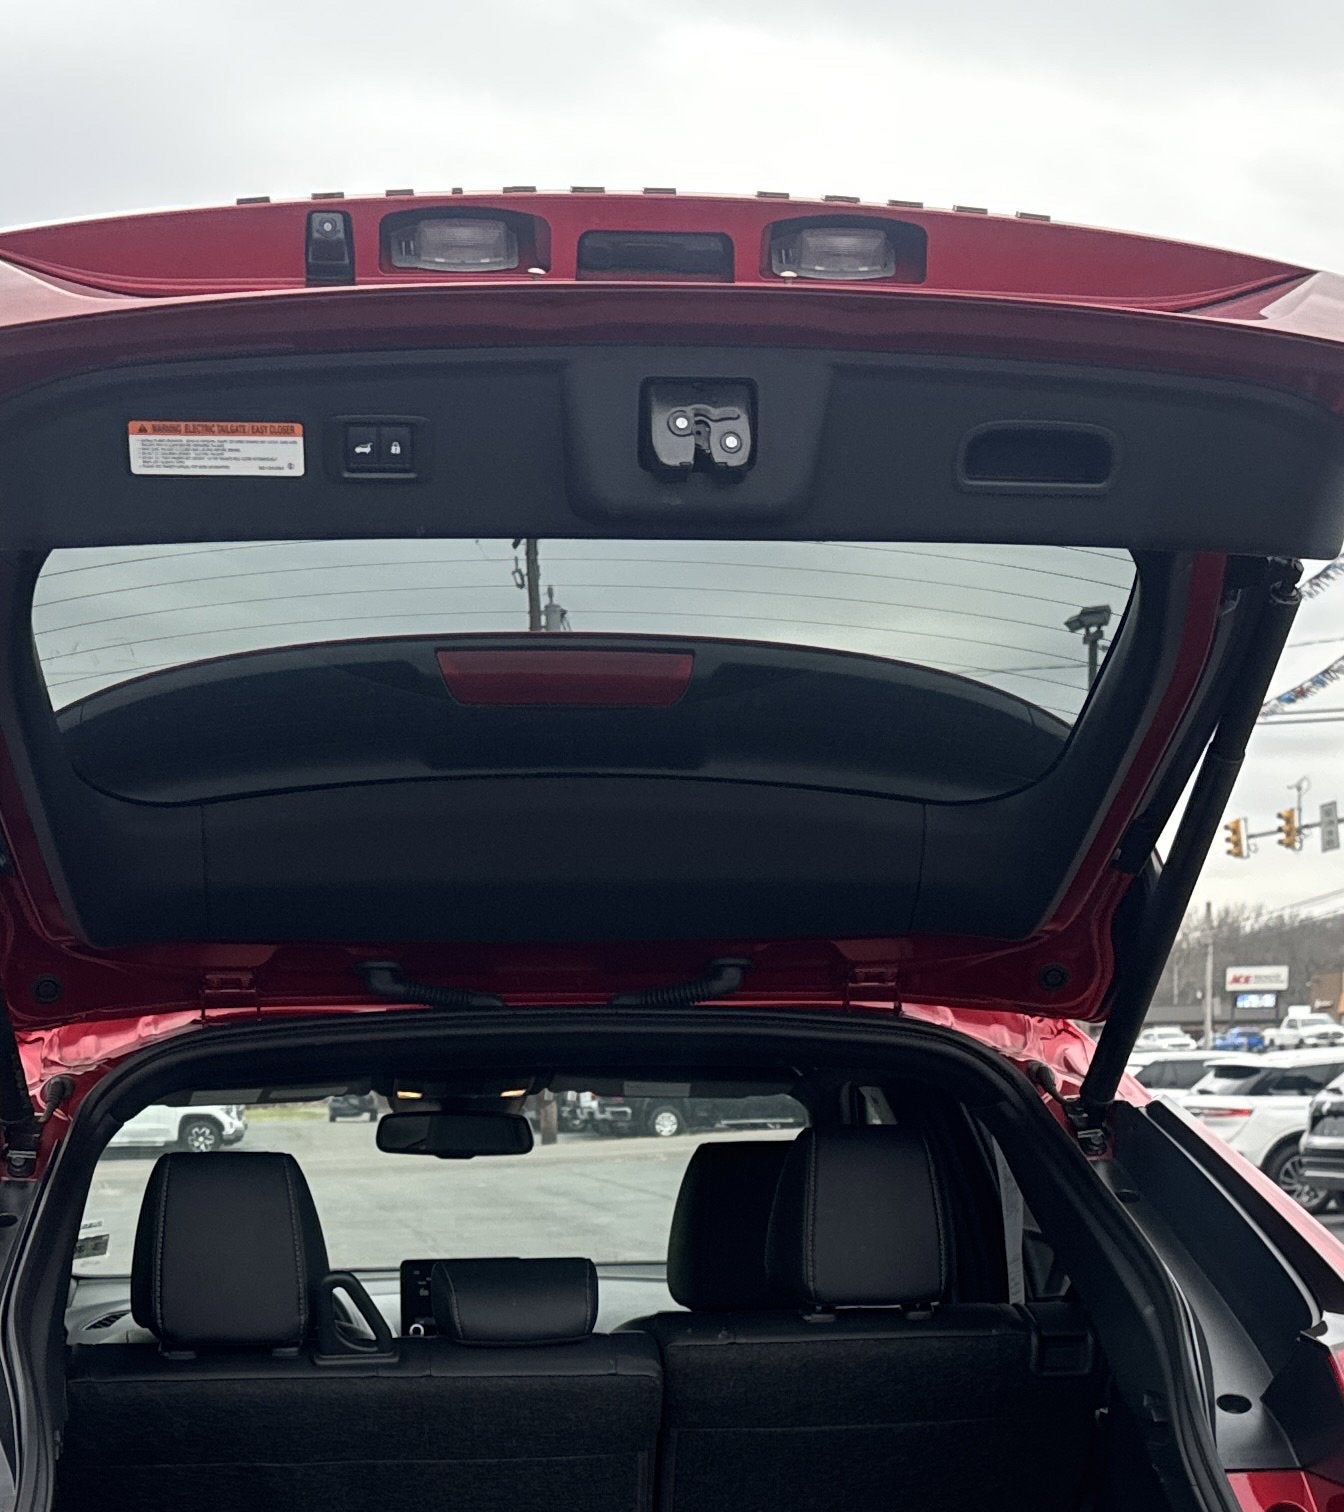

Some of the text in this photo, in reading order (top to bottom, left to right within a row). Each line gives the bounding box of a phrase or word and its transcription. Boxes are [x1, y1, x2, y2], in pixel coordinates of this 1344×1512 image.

[152, 424, 181, 434] WARNING
[185, 424, 215, 434] ELECTRIC
[217, 424, 246, 435] TAILGATE
[251, 425, 268, 435] EASY
[269, 425, 295, 435] CLOSER
